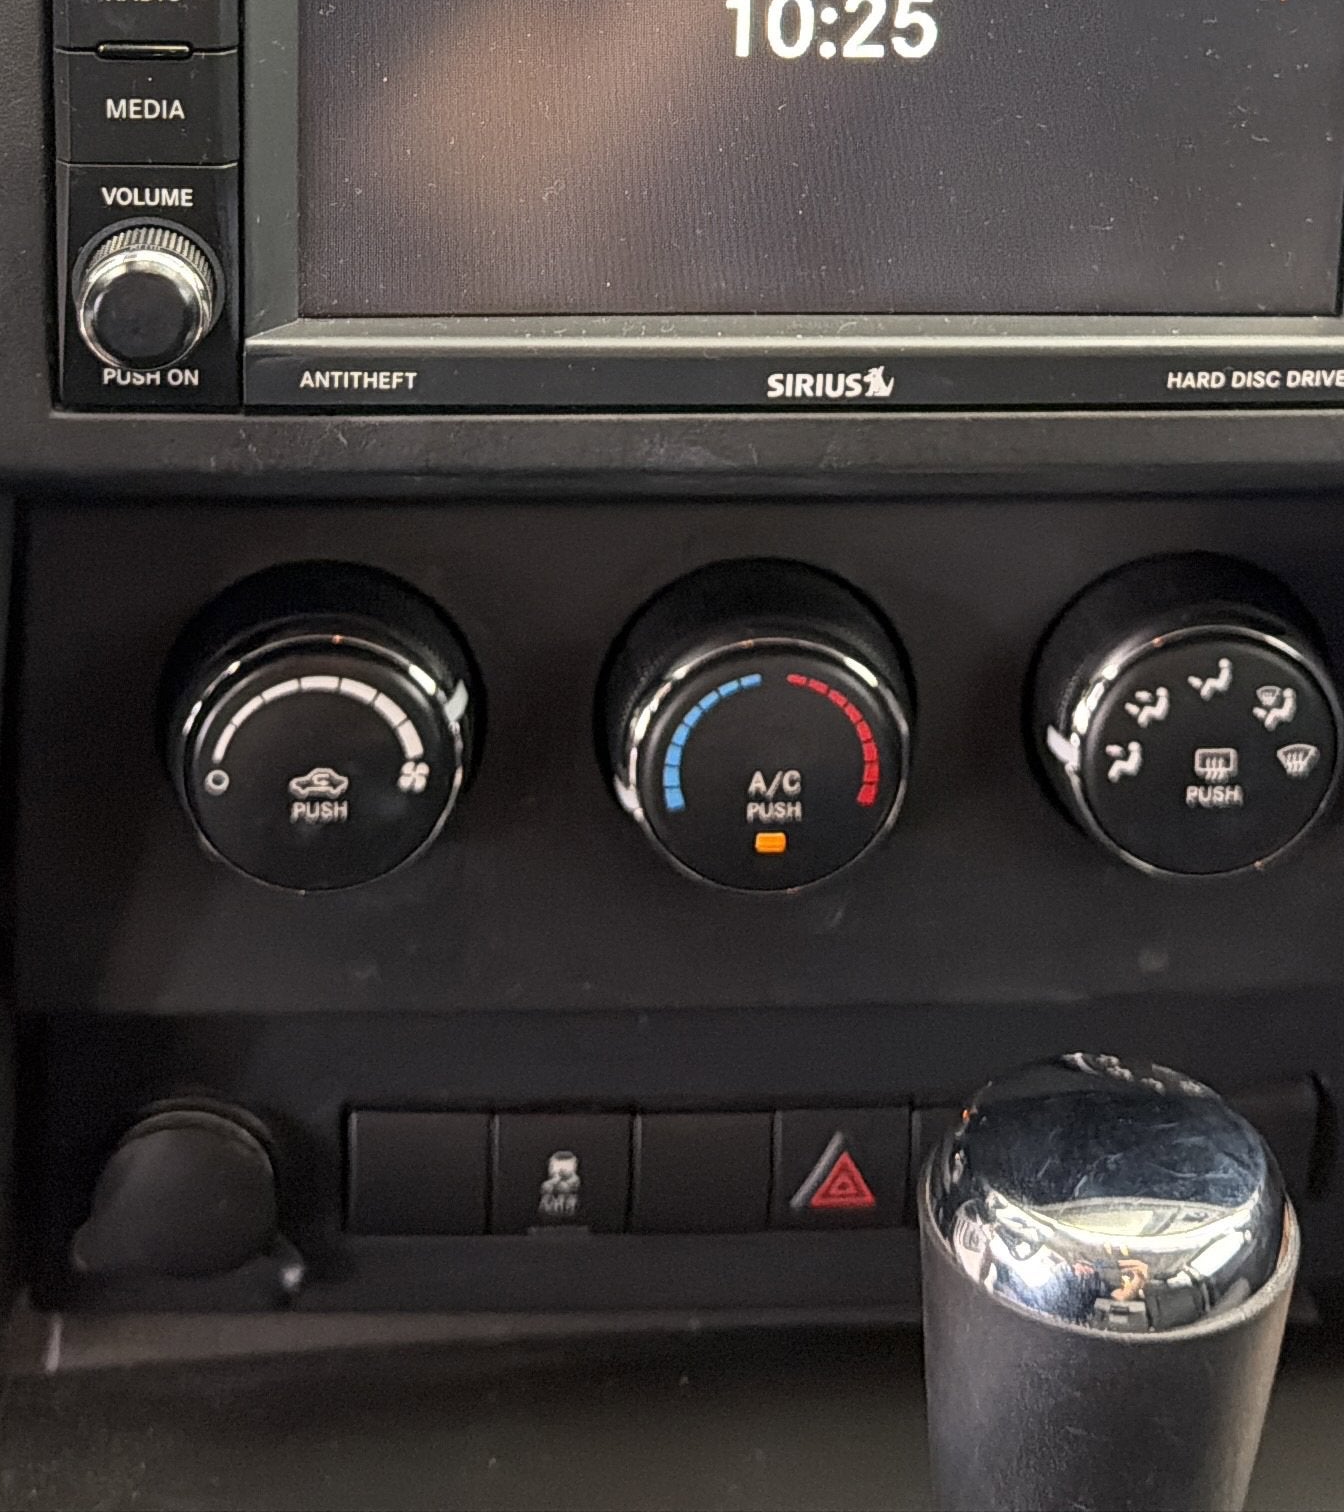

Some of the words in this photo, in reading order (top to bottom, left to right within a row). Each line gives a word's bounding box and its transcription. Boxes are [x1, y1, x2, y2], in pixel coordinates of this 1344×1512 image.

[106, 99, 185, 119] MEDIA
[101, 187, 193, 206] VOLUME
[103, 368, 160, 386] PUSH
[167, 368, 199, 386] ON
[300, 371, 417, 390] ANTITHEFT
[767, 373, 862, 397] SIRIUS
[1167, 372, 1225, 389] HARD
[1231, 371, 1282, 388] DISC
[748, 770, 802, 799] A/C
[1185, 785, 1244, 807] PUSH
[290, 800, 348, 823] PUSH
[746, 801, 802, 822] PUSH
